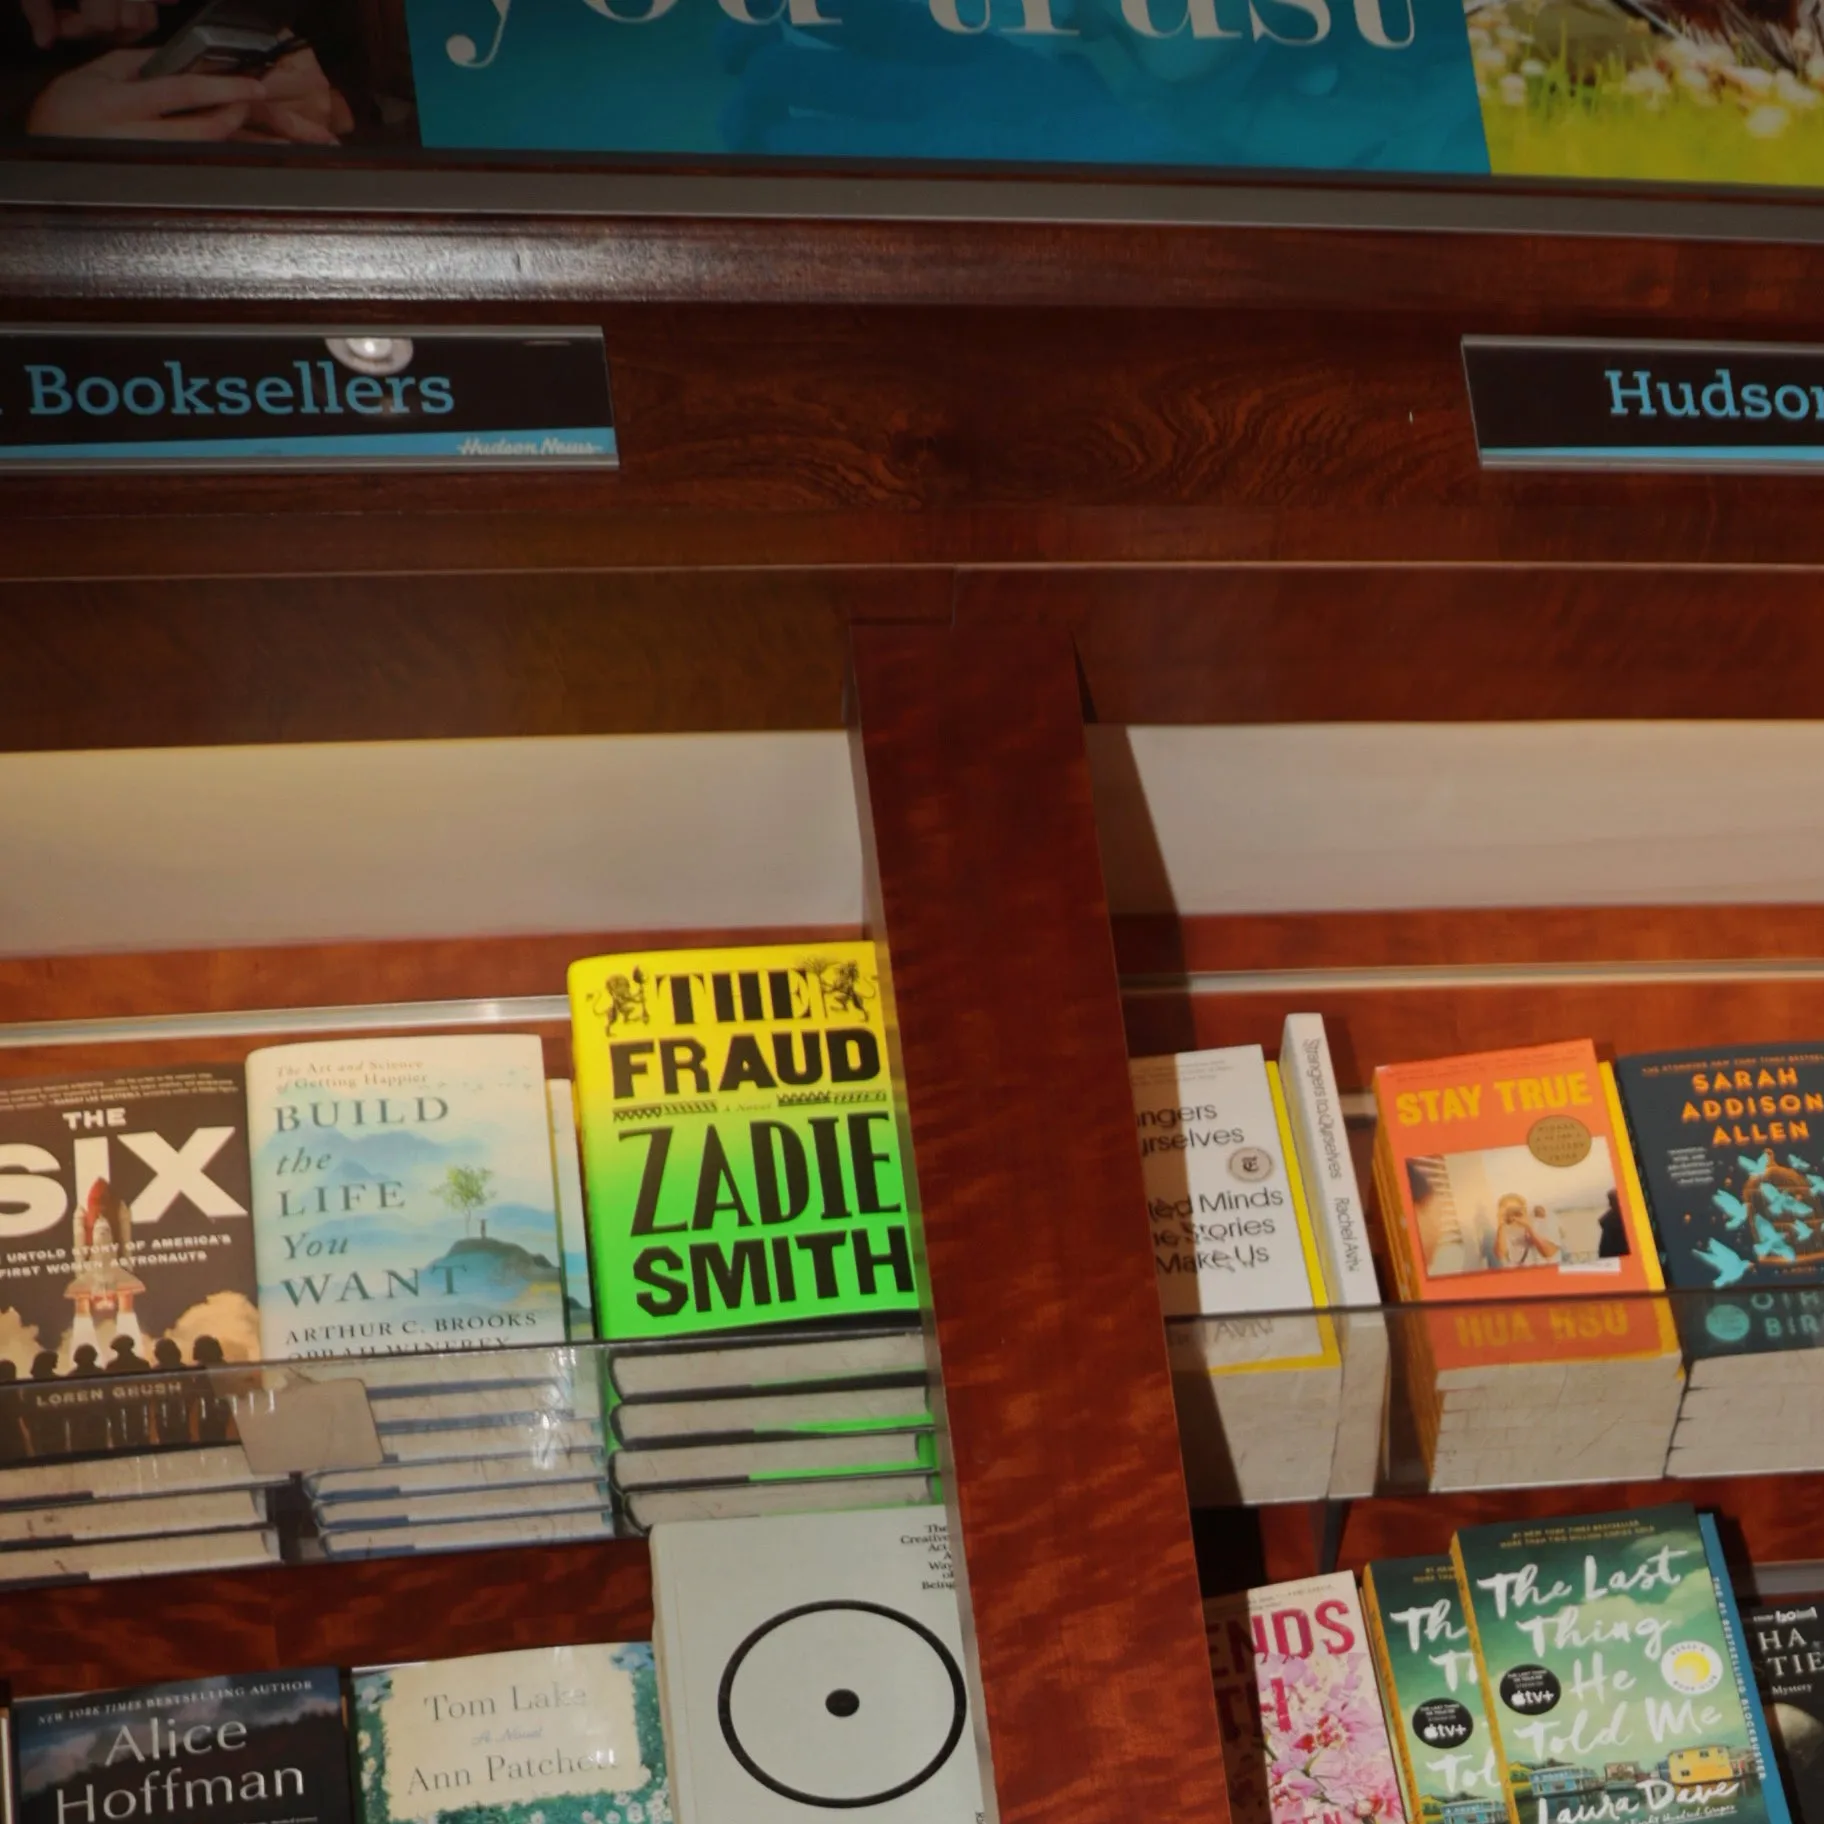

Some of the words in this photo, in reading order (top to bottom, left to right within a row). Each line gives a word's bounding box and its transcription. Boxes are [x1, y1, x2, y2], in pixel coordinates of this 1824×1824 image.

[26, 361, 455, 418] Booksellers
[655, 967, 814, 1026] THE
[611, 1028, 881, 1099] FRAUD
[1691, 1067, 1799, 1094] SARAH
[275, 1095, 450, 1136] BUILD
[1396, 1084, 1482, 1129] STAY
[1496, 1070, 1592, 1114] TRUE
[1681, 1093, 1824, 1122] ADDISON
[1712, 1121, 1811, 1147] ALLEN
[276, 1147, 332, 1177] the
[619, 1112, 902, 1238] ZADIE
[278, 1183, 407, 1218] LIFE
[281, 1232, 350, 1260] You
[281, 1264, 468, 1309] WANT
[633, 1226, 915, 1318] SMITH
[1477, 1564, 1573, 1619] The
[1583, 1547, 1688, 1598] Last
[1515, 1611, 1672, 1661] Thing
[1573, 1659, 1636, 1701] He
[105, 1715, 248, 1769] Alice
[1513, 1713, 1630, 1760] Told
[1647, 1703, 1723, 1744] Me
[1647, 1778, 1741, 1812] Dave
